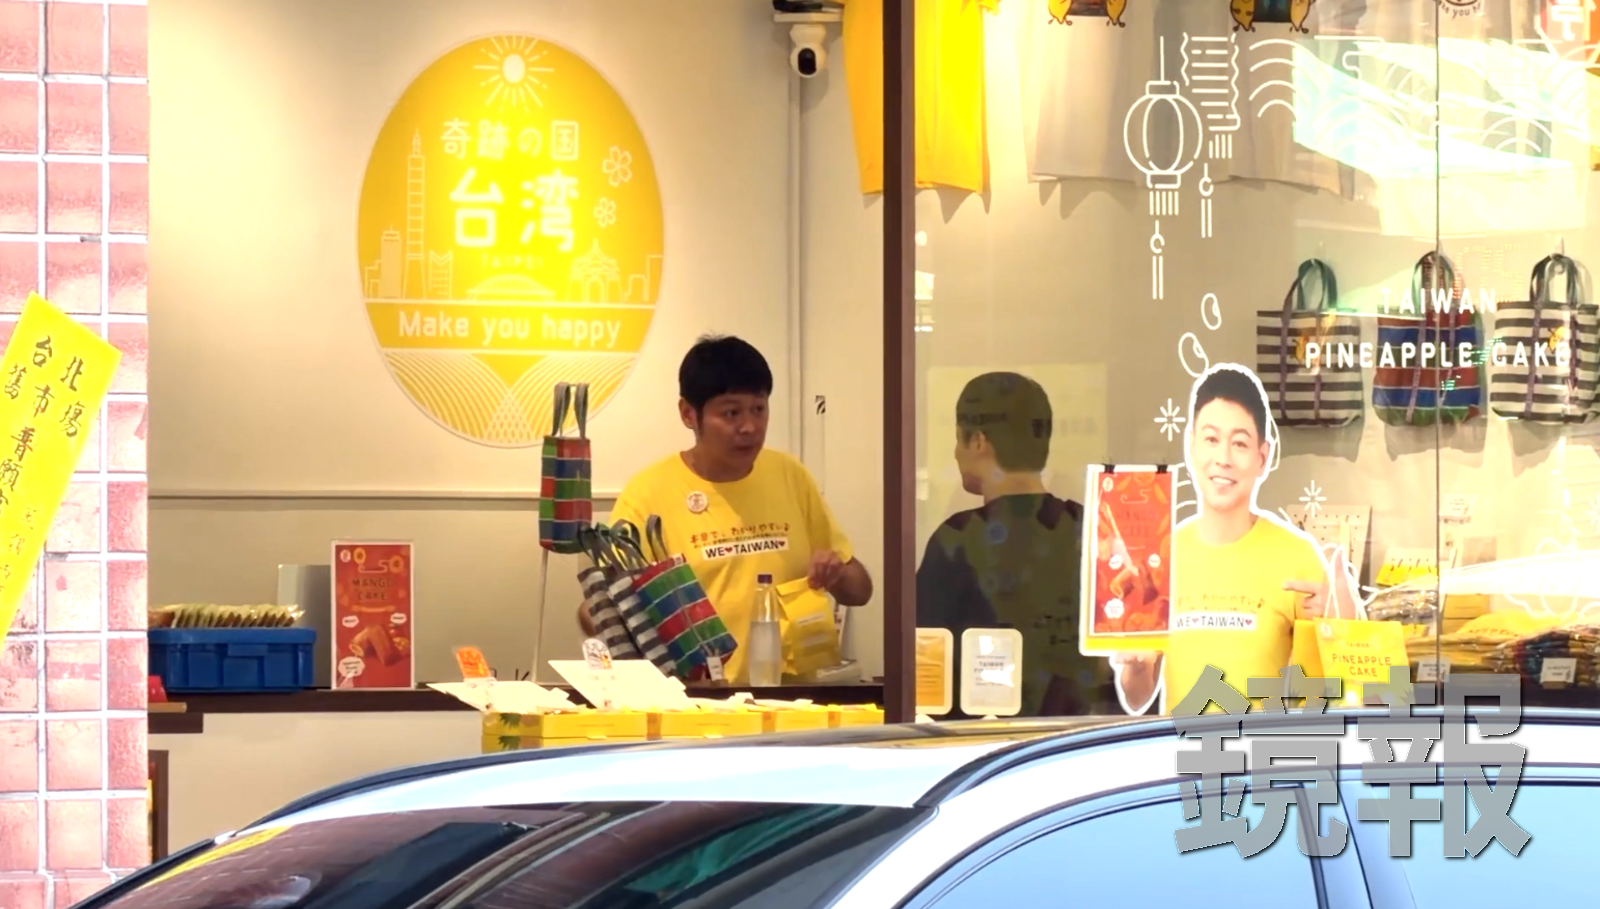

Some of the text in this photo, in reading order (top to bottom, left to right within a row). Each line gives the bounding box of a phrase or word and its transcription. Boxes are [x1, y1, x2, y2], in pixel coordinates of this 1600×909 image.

[1452, 7, 1470, 19] you
[440, 117, 579, 160] 奇跡の国
[449, 166, 580, 252] 台湾
[481, 254, 544, 270] TAIPEI
[1380, 287, 1498, 314] TAIWAN
[398, 310, 621, 348] Make you happy
[1304, 341, 1571, 368] PINEAPPLE CAKE
[358, 591, 388, 601] CAKE
[1332, 652, 1392, 667] PINEAPPLE
[1348, 665, 1378, 678] CAKE
